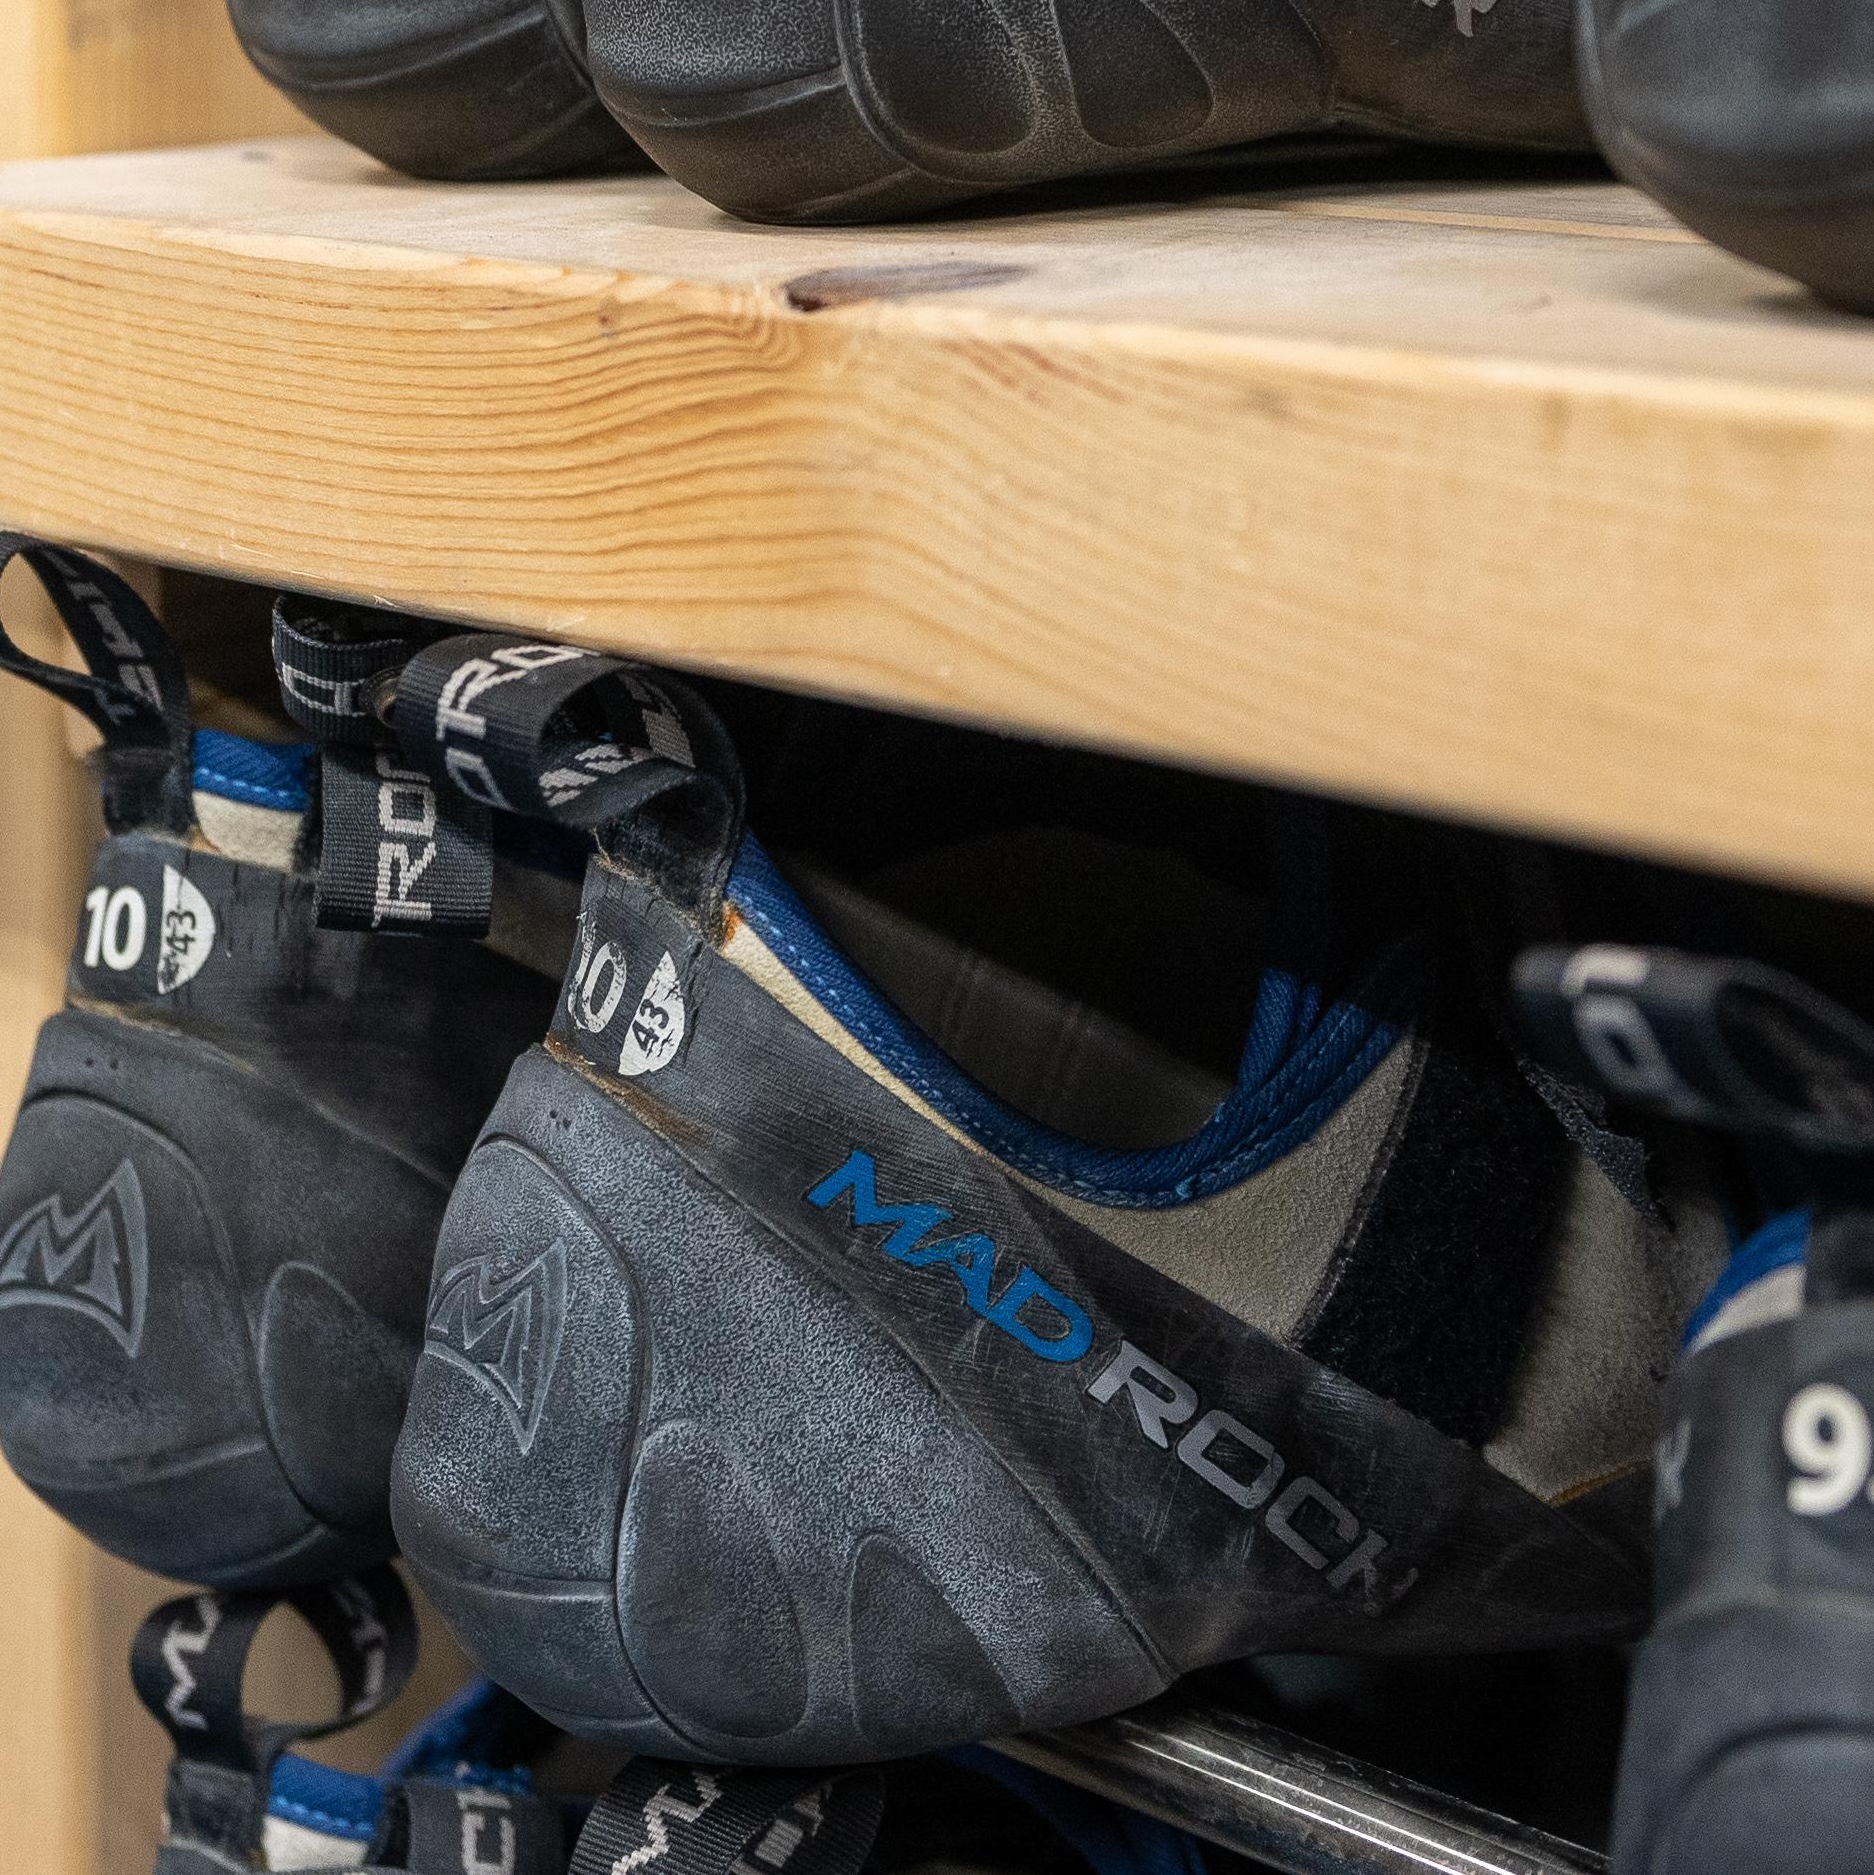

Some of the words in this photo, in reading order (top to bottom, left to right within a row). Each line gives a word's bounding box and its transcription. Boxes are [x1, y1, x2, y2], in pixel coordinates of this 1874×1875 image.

[83, 885, 148, 972] 10
[166, 909, 197, 956] 43
[631, 998, 670, 1053] 43
[807, 1150, 1094, 1363] MAD
[1087, 1340, 1419, 1616] ROCK
